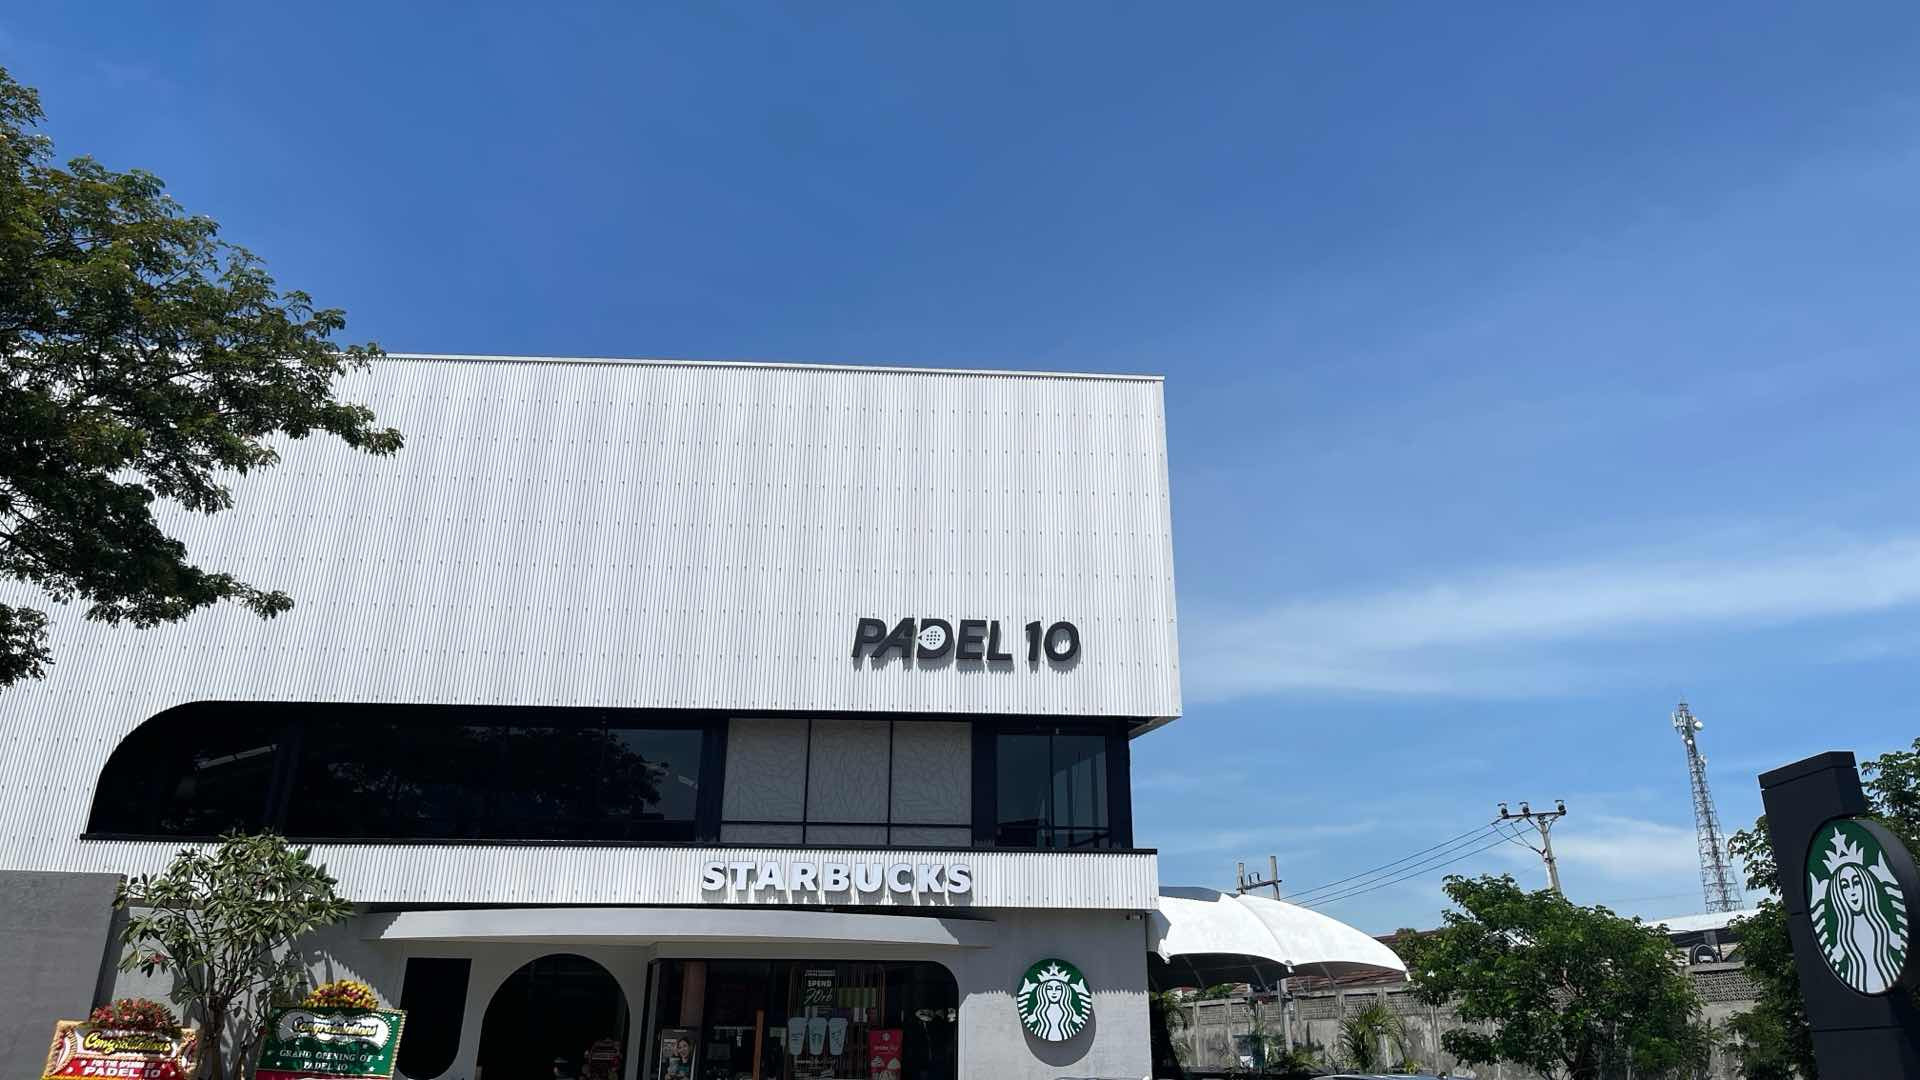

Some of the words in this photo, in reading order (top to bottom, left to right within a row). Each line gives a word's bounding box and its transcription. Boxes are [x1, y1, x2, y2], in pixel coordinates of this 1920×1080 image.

[852, 617, 1013, 661] PADEL
[1025, 620, 1080, 662] 10
[702, 861, 971, 894] STARBUCKS
[293, 1016, 378, 1035] Congratulations
[279, 1050, 312, 1058] GRAND
[315, 1051, 356, 1061] OPENING
[360, 1054, 373, 1063] OF
[84, 1067, 140, 1077] PADEL
[303, 1061, 331, 1070] PADEL
